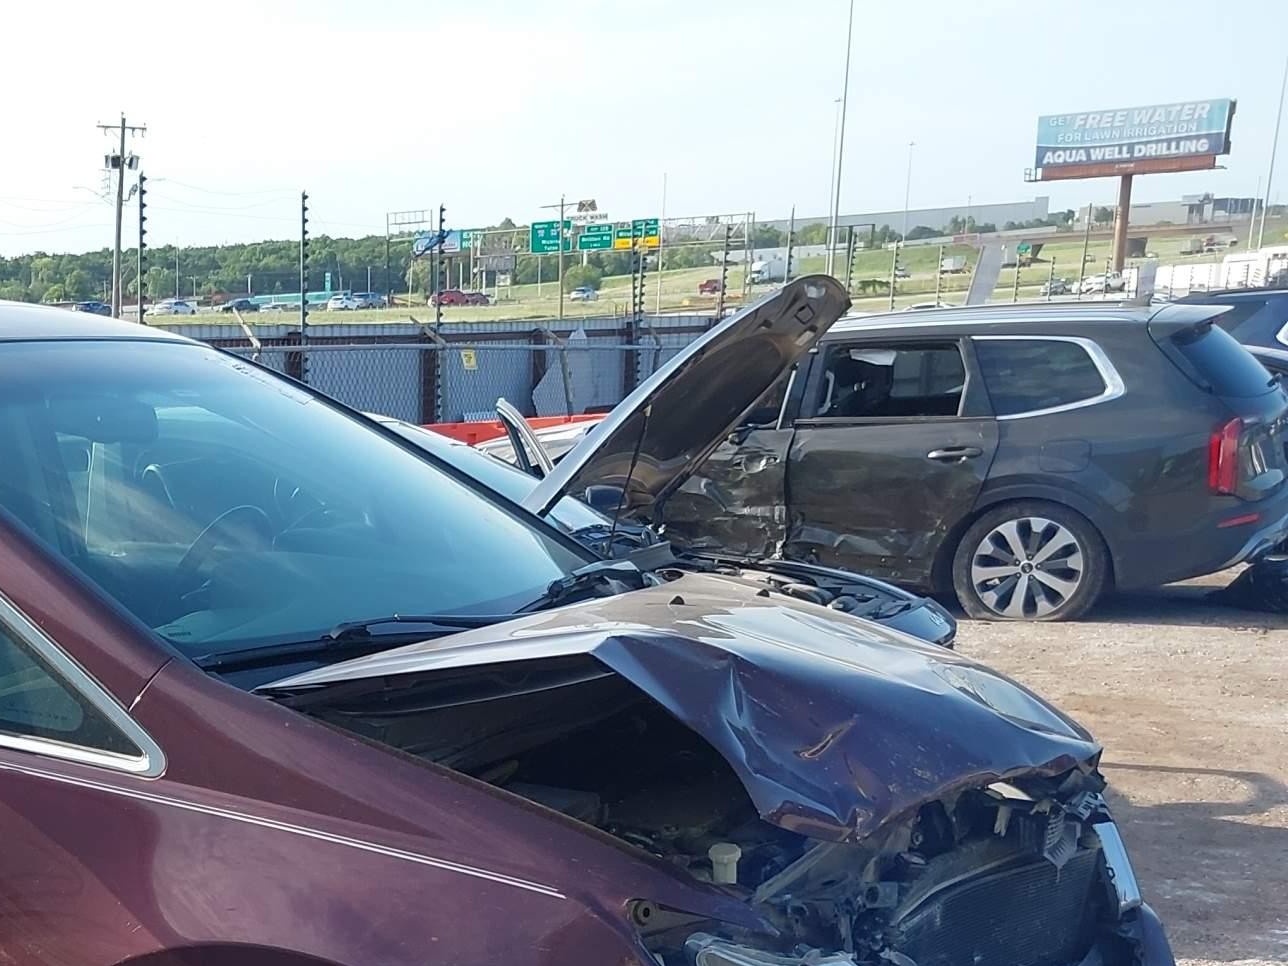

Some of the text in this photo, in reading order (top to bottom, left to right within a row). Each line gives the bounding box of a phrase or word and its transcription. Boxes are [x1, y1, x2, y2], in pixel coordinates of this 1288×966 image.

[1049, 104, 1210, 130] GET FREE WATER
[1057, 122, 1198, 144] FOR LAWN IRRIGATION
[1043, 138, 1209, 165] AQUA WELL DRILLING
